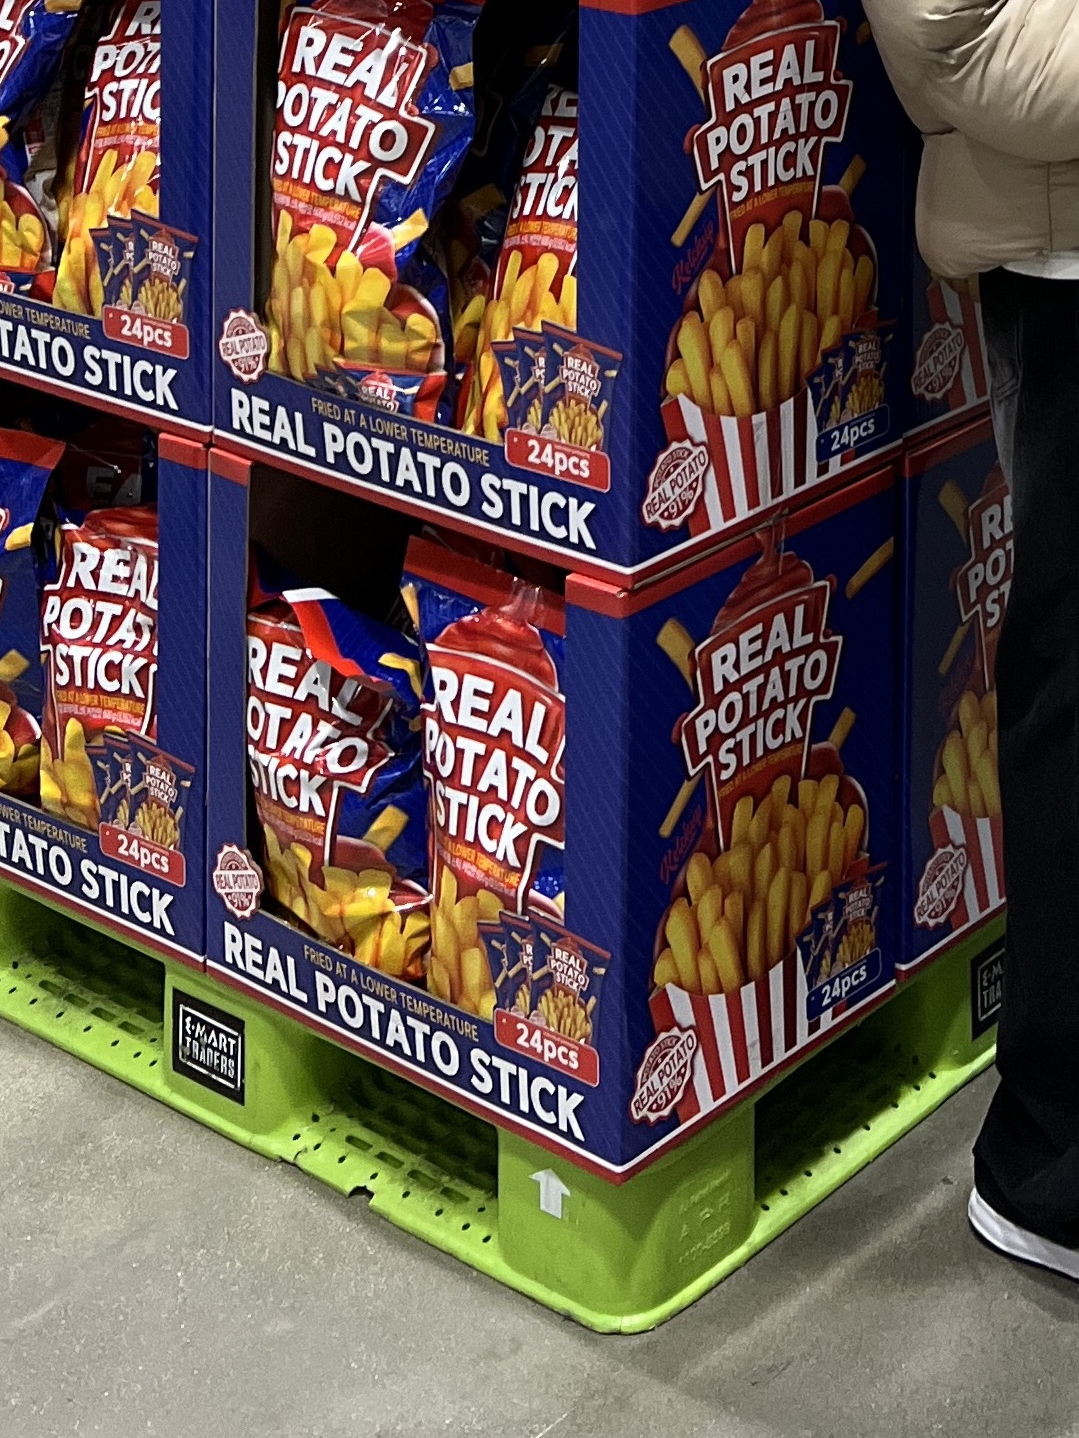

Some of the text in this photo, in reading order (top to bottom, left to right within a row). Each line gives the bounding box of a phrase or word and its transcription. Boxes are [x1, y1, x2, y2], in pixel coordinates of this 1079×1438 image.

[291, 25, 409, 109] REAL
[722, 39, 825, 113] REAL
[706, 88, 839, 172] POTATO
[274, 130, 373, 203] STICK
[730, 135, 819, 203] STICK
[24, 306, 91, 340] TEMPERATURE
[120, 314, 173, 347] 24pcs
[0, 319, 179, 411] TATO STICK
[562, 367, 598, 391] POTATO
[567, 356, 594, 378] REAL
[567, 382, 591, 399] STICK
[311, 397, 490, 467] FRIED AT A LOWER TEMPERATURE
[527, 439, 590, 479] 24pcs
[830, 419, 876, 452] 24pcs
[231, 387, 597, 550] REAL POTATO STICK
[645, 449, 707, 519] REAL POTATO
[668, 487, 695, 518] 91%
[55, 642, 149, 699] STICK
[248, 635, 363, 726] REAL
[711, 603, 815, 695] REAL
[246, 695, 368, 774] OTATO
[431, 665, 550, 765] REAL
[695, 648, 828, 756] POTATO
[425, 718, 561, 828] POTATO
[718, 697, 808, 781] STICK
[21, 812, 88, 853] TEMPERATURE
[117, 833, 170, 874] 24pcs
[435, 780, 529, 868] STICK
[80, 858, 176, 937] STICK
[917, 852, 965, 921] REAL POTATO
[304, 944, 479, 1043] FRIED AT A LOWER TEMPERATURE
[550, 960, 586, 985] POTATO
[553, 948, 583, 973] REAL
[555, 971, 580, 991] STICK
[820, 965, 868, 1007] 24pcs
[183, 1036, 236, 1080] TRADERS
[223, 920, 586, 1142] REAL POTATO STICK
[515, 1022, 580, 1070] 24pcs
[633, 1034, 696, 1117] REAL POTATO
[657, 1074, 684, 1106] 91%
